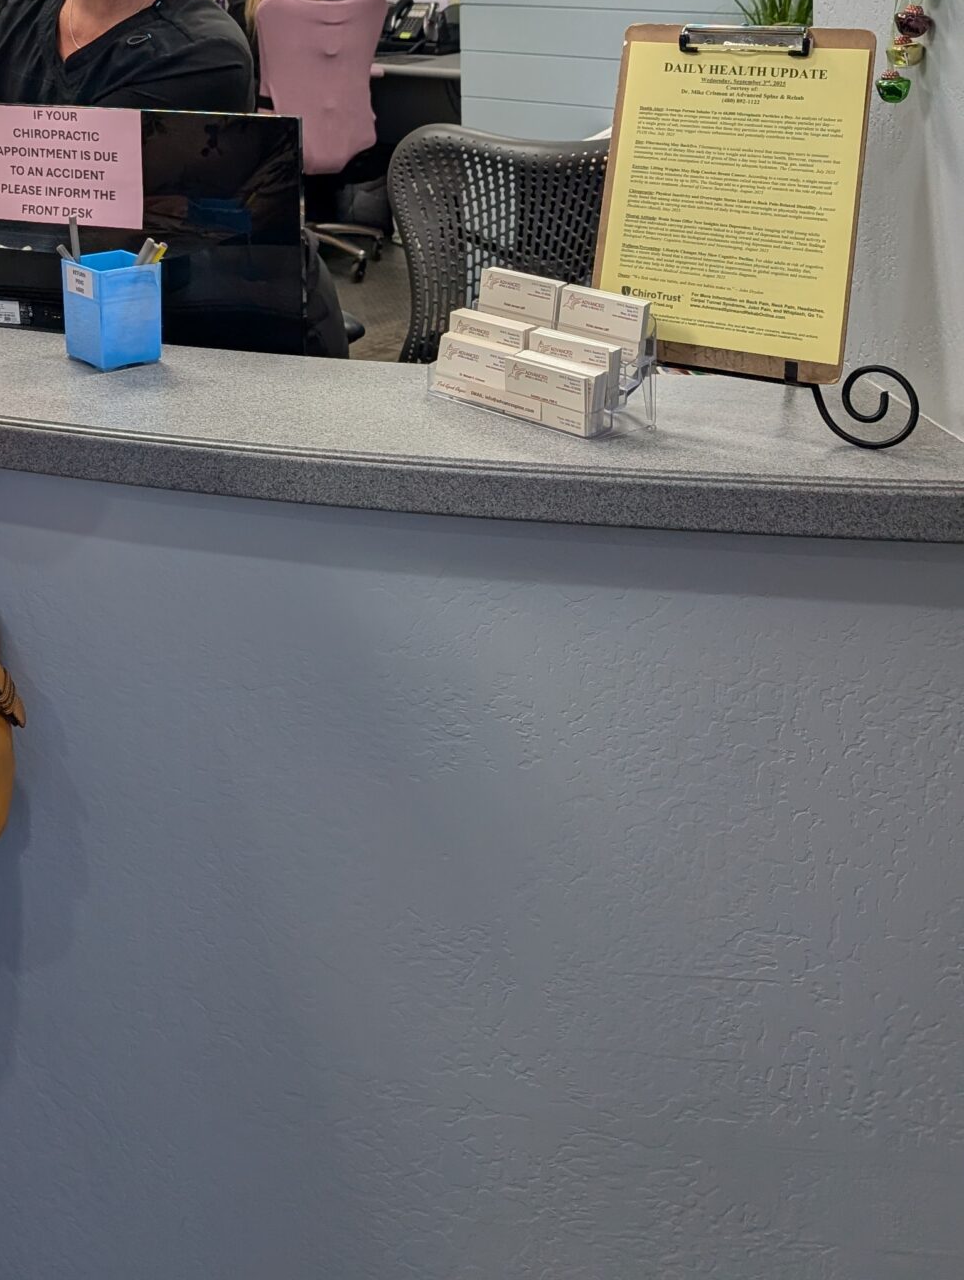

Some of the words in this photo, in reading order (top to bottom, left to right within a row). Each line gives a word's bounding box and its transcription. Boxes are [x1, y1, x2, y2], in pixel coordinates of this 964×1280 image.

[664, 62, 707, 74] DAILY
[709, 65, 767, 76] HEALTH
[771, 67, 828, 79] UPDATE
[33, 111, 43, 119] IF
[46, 111, 77, 121] YOUR
[13, 128, 100, 141] CHIROPRACTIC
[81, 151, 90, 160] IS
[94, 152, 118, 162] DUE
[10, 166, 24, 176] TO
[27, 167, 43, 177] AN
[46, 168, 105, 180] ACCIDENT
[1, 184, 41, 195] PLEASE
[45, 187, 90, 199] INFORM
[93, 190, 116, 200] THE
[22, 204, 59, 216] FRONT
[62, 207, 92, 219] DESK
[632, 289, 681, 302] ChiroTrust
